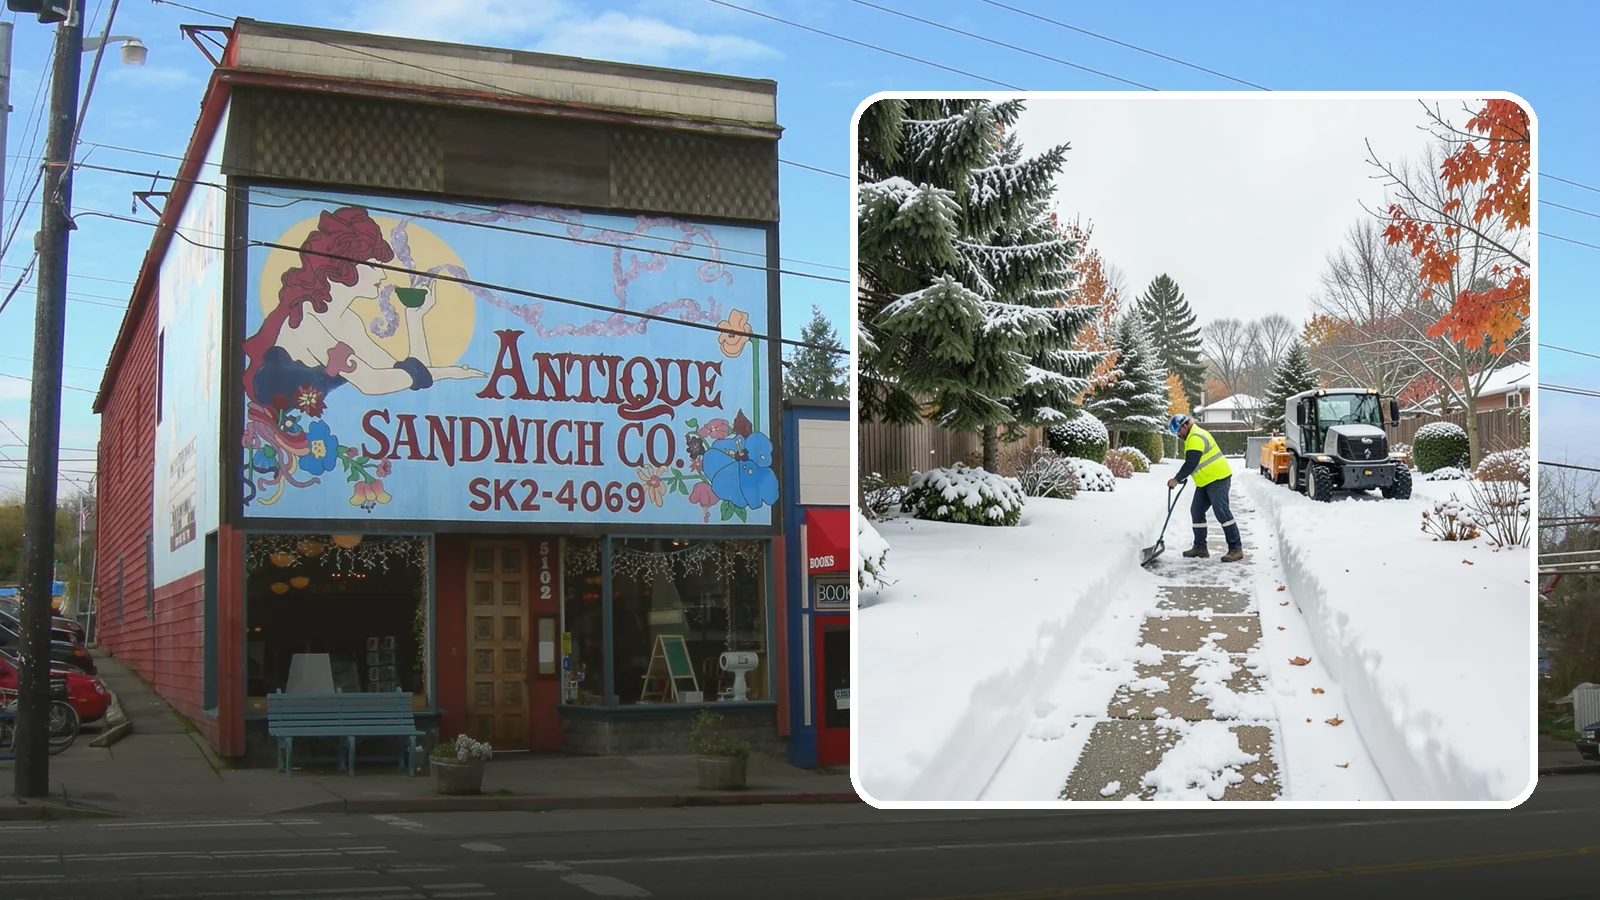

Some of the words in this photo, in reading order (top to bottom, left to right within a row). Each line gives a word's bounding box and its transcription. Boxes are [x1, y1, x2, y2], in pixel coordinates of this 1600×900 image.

[476, 329, 723, 421] ANTIQUE
[361, 408, 605, 467] SANDWICH
[617, 422, 685, 469] CO.
[468, 476, 647, 514] SK2-4069
[540, 543, 551, 599] 5102
[809, 555, 834, 569] BOOKS
